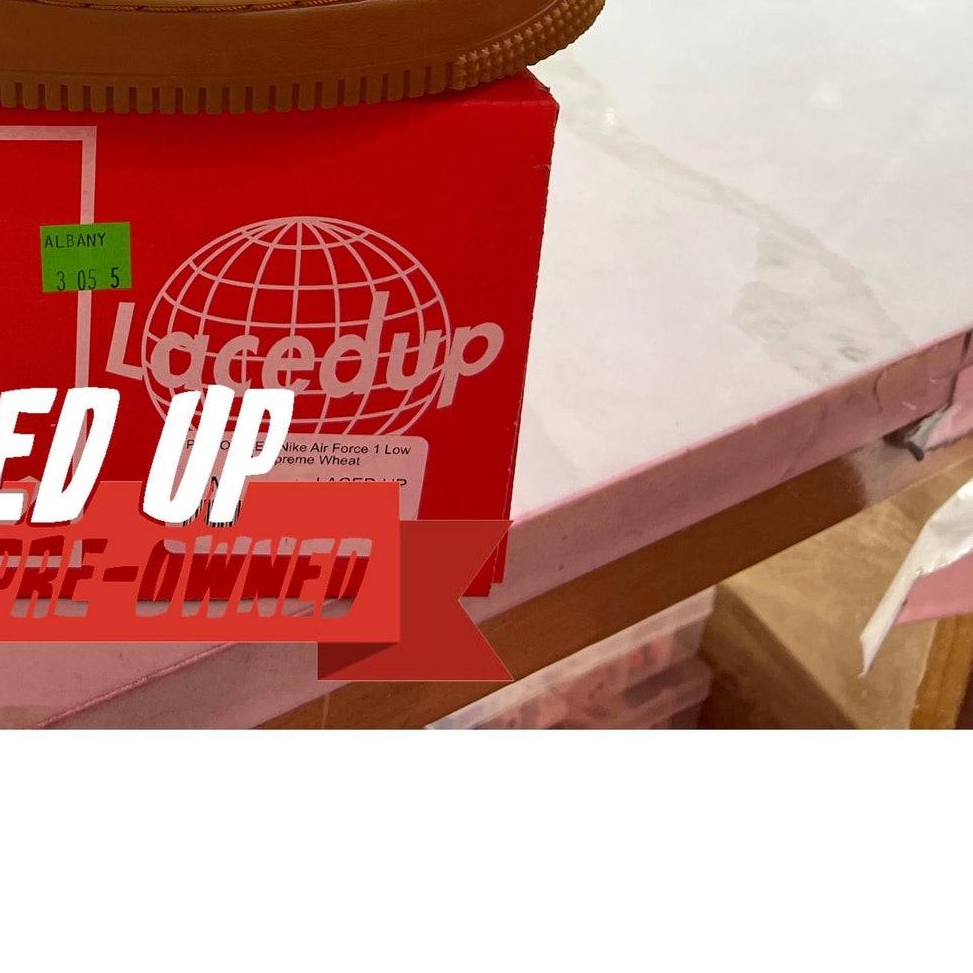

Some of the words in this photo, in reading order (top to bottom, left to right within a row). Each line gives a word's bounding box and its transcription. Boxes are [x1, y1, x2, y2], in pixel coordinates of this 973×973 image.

[44, 233, 106, 248] ALBANY
[56, 270, 66, 291] 3
[110, 267, 120, 289] 5
[105, 290, 505, 410] Lacedup
[281, 442, 307, 453] Nike
[310, 442, 328, 454] Air
[332, 443, 369, 455] Force
[373, 444, 380, 455] 1
[384, 444, 411, 456] Low
[274, 455, 315, 467] preme
[319, 455, 361, 467] Wheat
